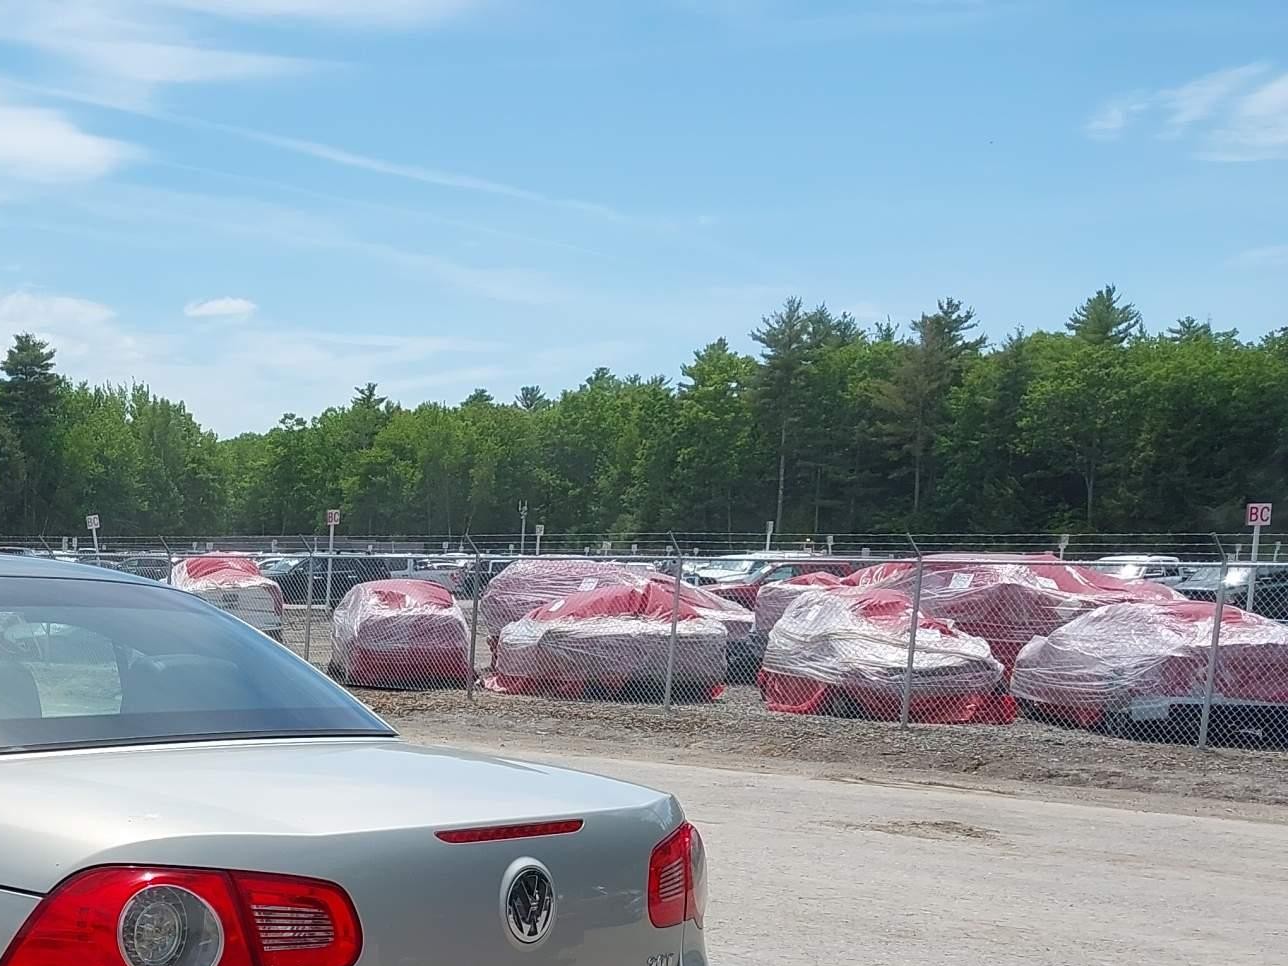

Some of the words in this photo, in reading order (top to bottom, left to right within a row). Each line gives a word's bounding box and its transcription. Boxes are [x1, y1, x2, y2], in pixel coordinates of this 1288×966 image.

[328, 511, 339, 524] BC
[1249, 506, 1270, 523] BC
[87, 516, 99, 528] BC
